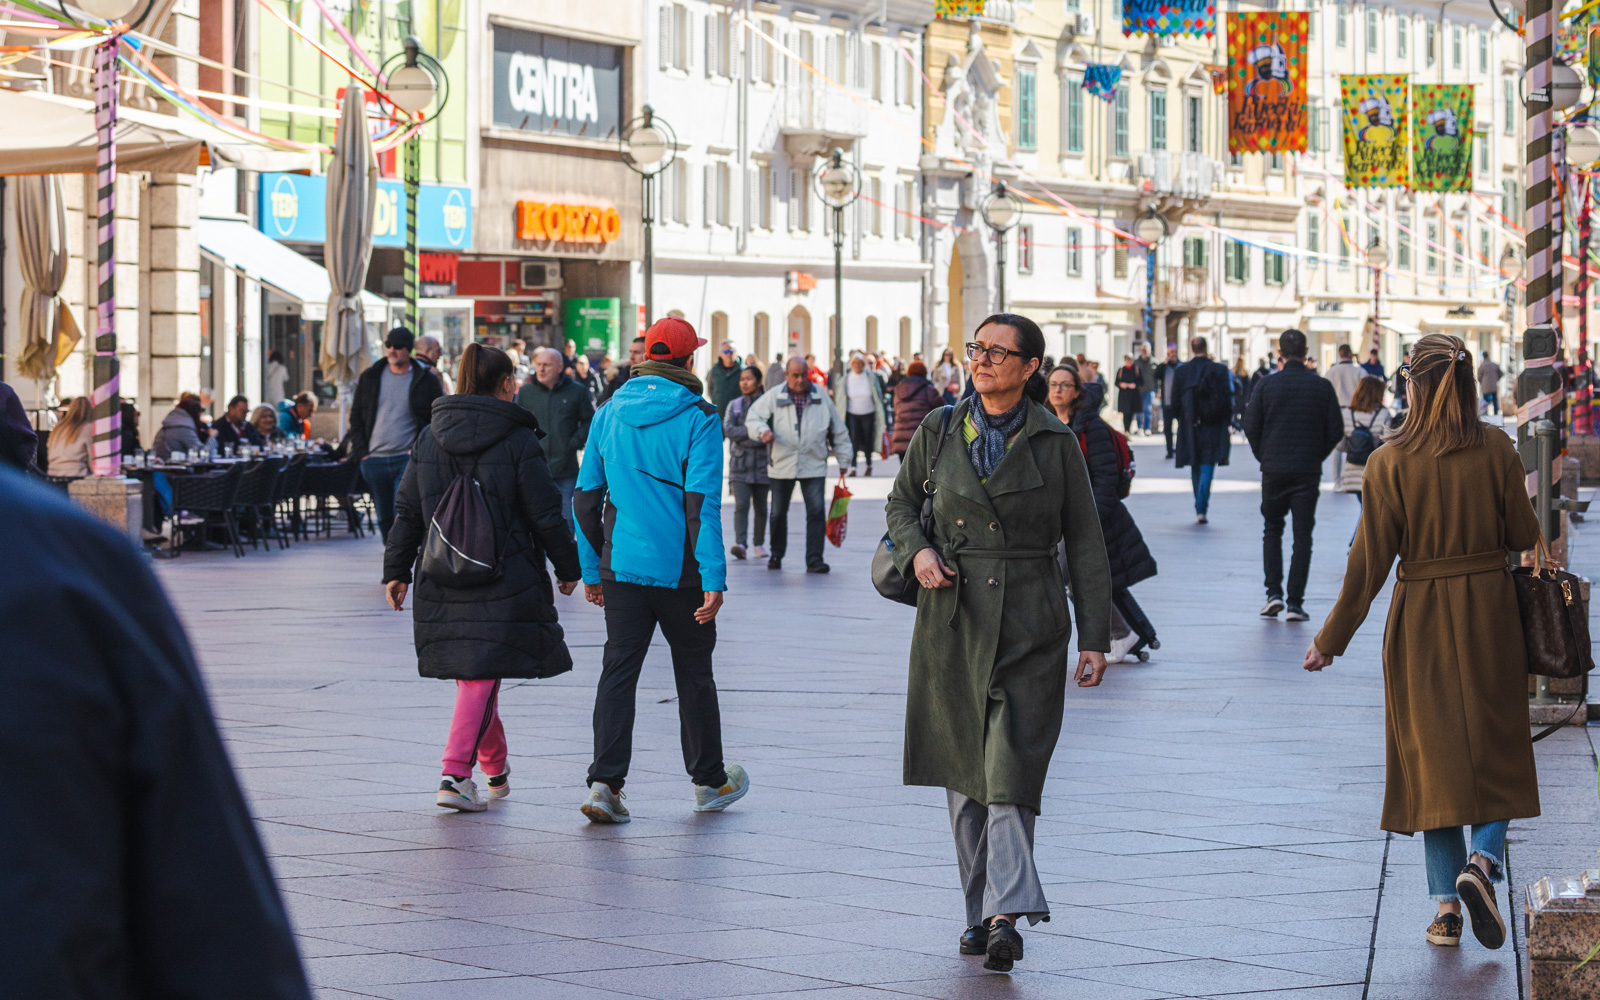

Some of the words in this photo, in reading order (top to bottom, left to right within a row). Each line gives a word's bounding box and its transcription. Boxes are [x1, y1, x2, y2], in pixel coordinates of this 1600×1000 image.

[509, 51, 598, 123] CENTRA
[372, 188, 398, 236] Di
[516, 200, 621, 243] KORZO
